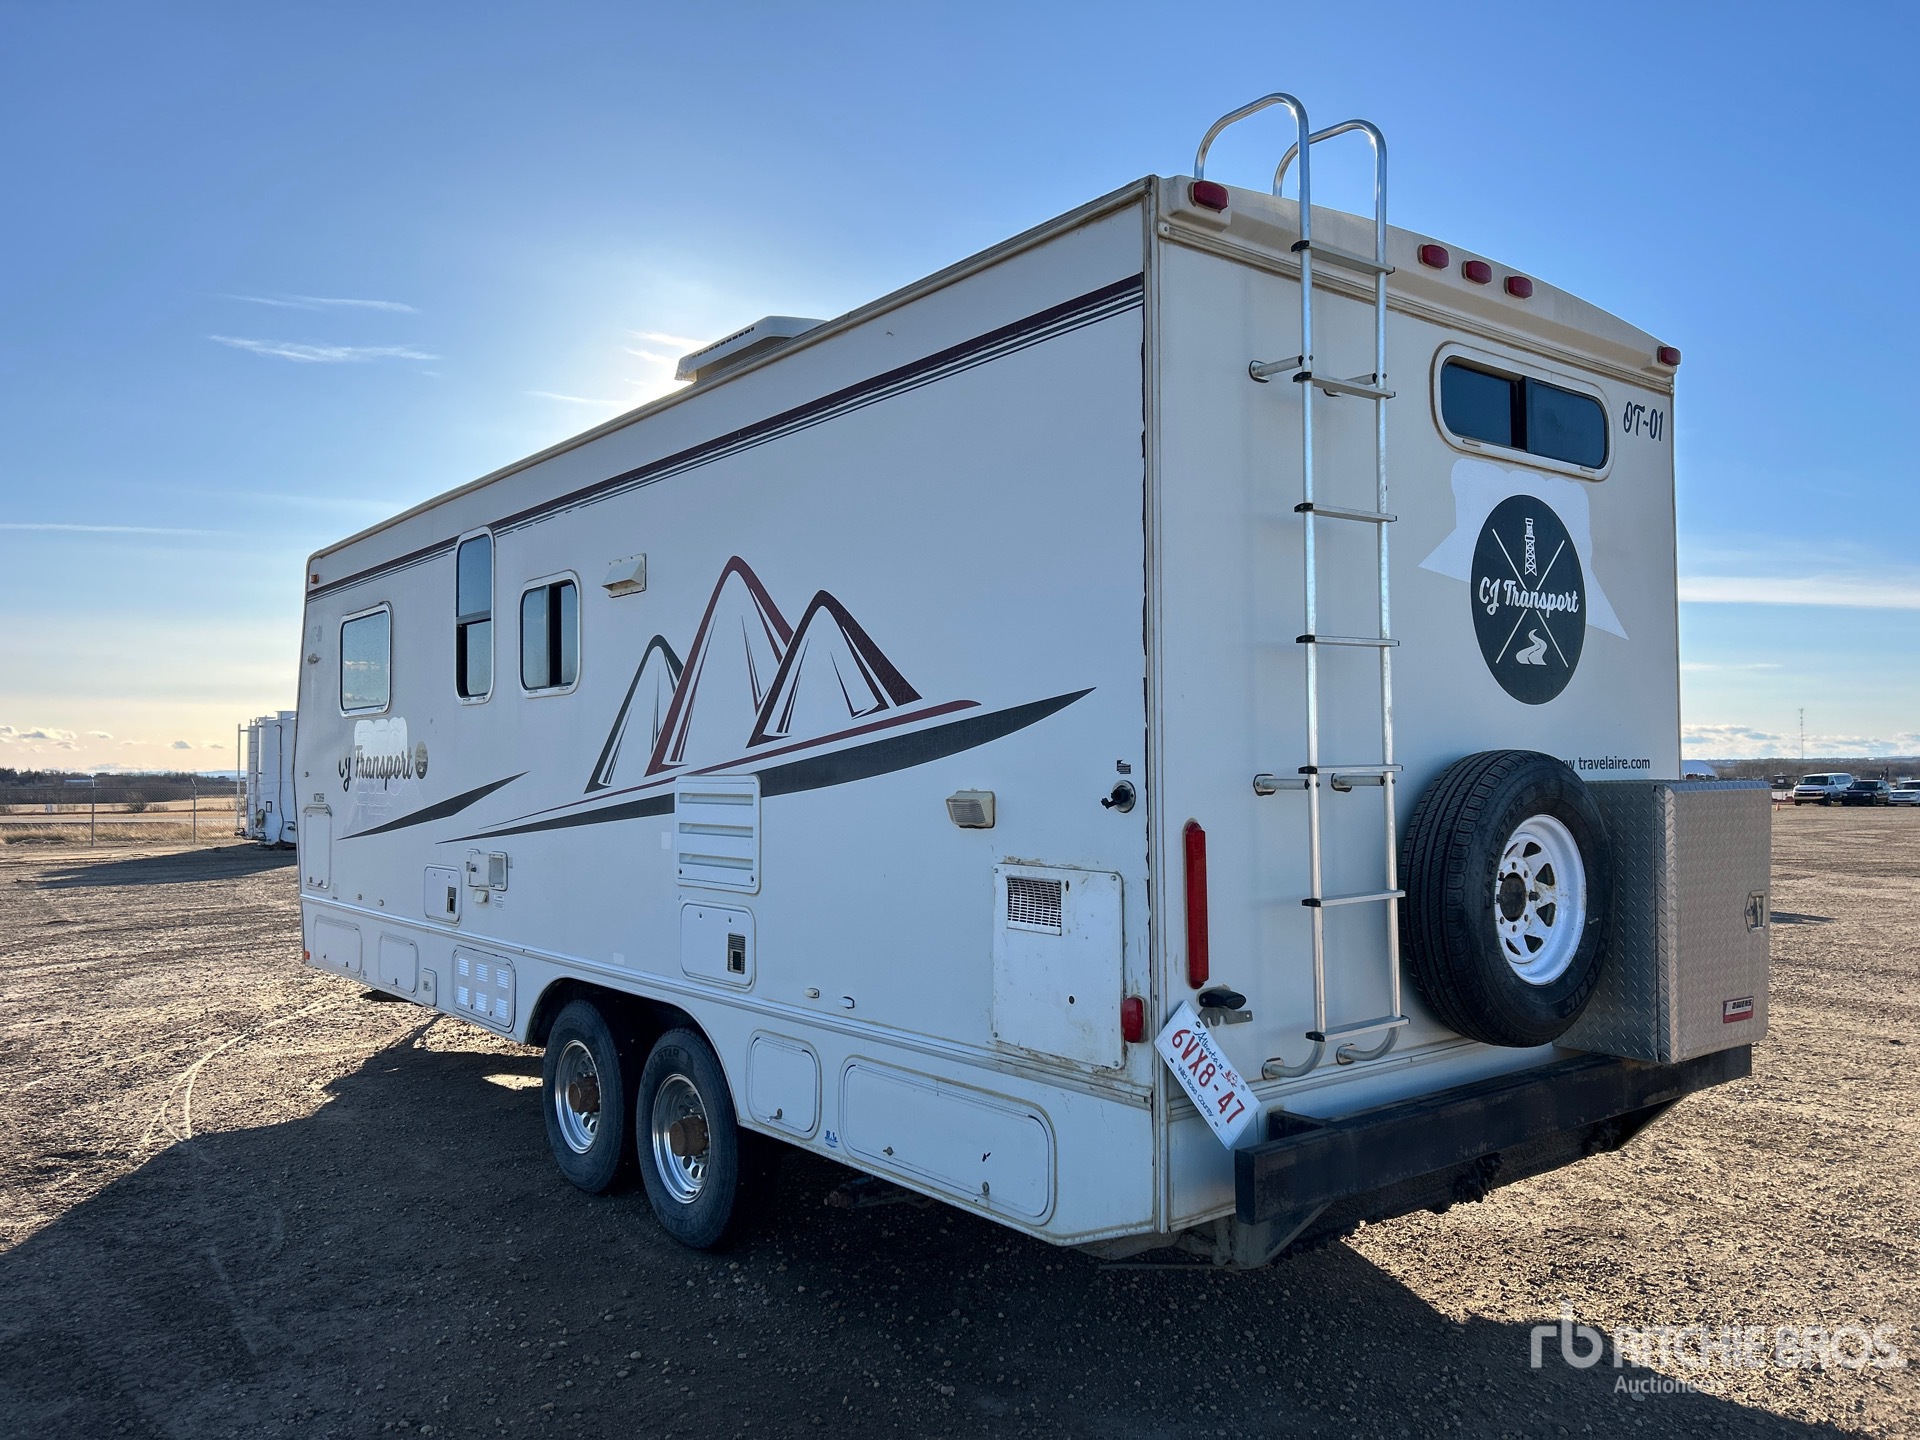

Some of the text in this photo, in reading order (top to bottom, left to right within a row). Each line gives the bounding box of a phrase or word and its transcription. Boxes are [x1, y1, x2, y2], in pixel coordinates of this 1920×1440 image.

[1479, 576, 1579, 618] CJ Transport
[354, 745, 414, 791] Transport
[1578, 755, 1651, 770] travelaire.com
[1193, 1031, 1223, 1070] Alberta
[1177, 1063, 1215, 1117] Wild Rose Country
